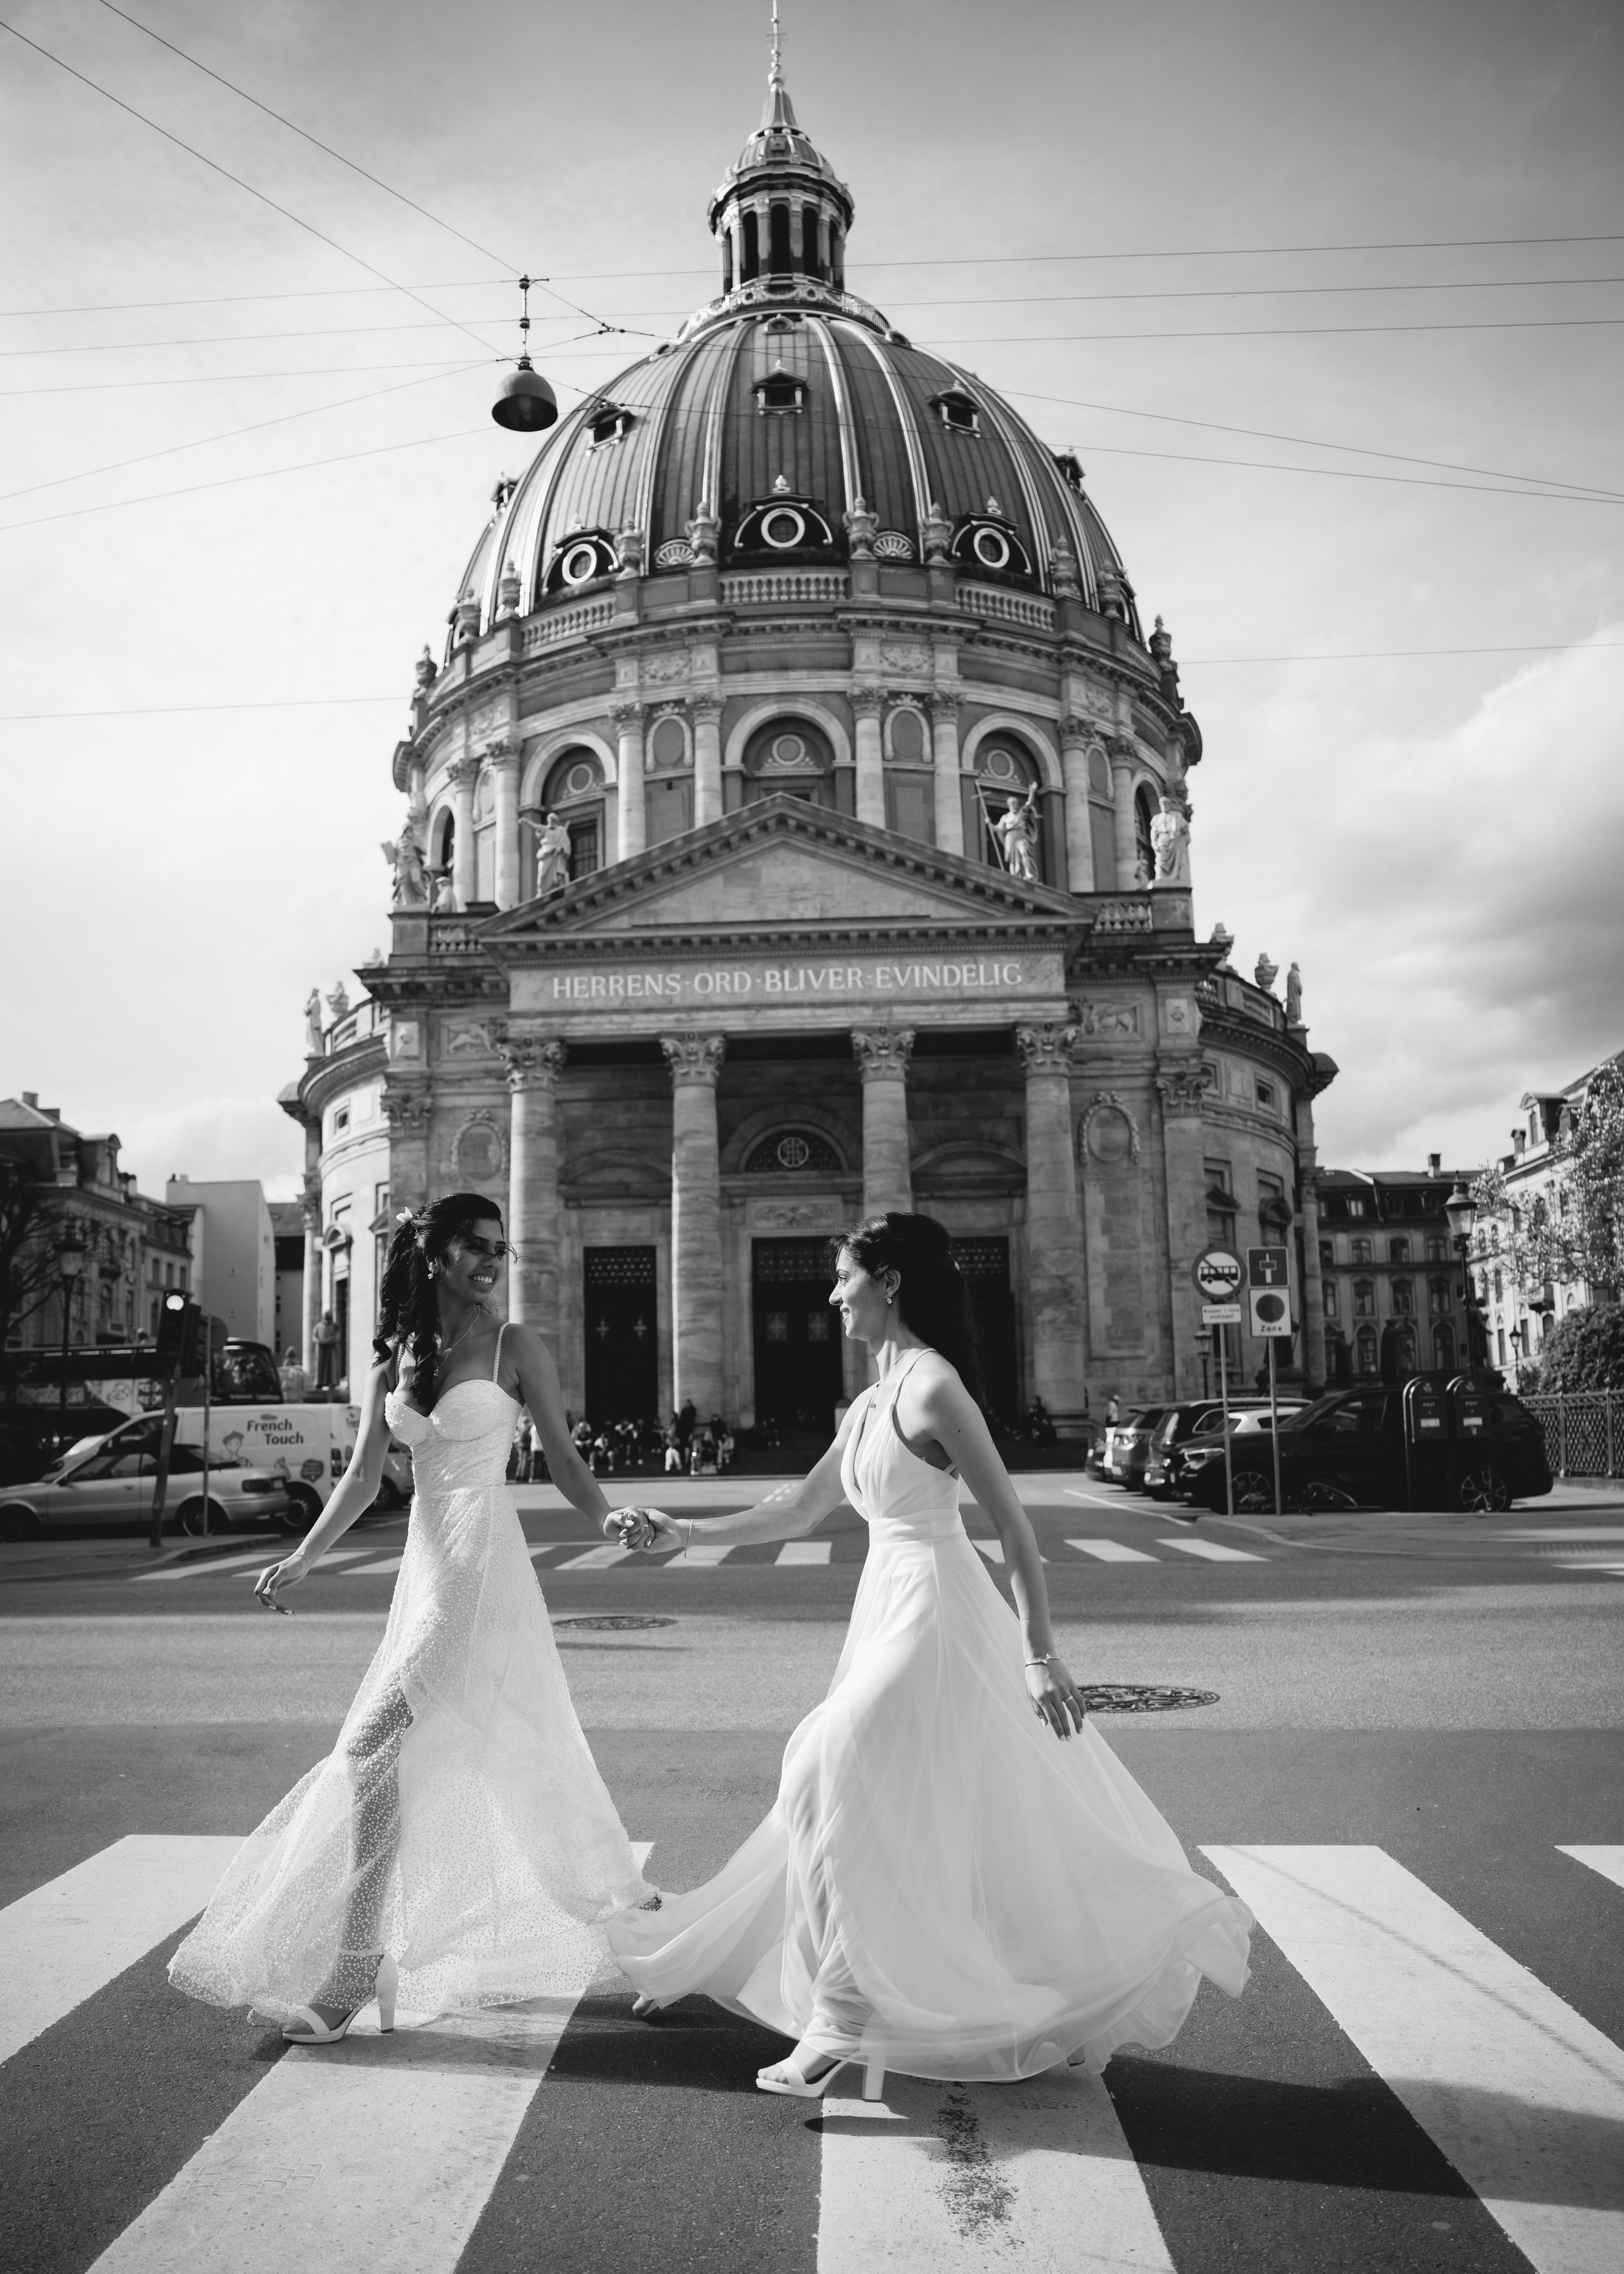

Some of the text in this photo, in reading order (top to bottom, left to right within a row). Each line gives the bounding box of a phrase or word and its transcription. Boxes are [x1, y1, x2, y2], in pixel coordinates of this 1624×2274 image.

[553, 963, 1023, 999] HERRENS ORD BLIVER EVINDELIG
[247, 1418, 292, 1431] French
[265, 1431, 304, 1445] Touch
